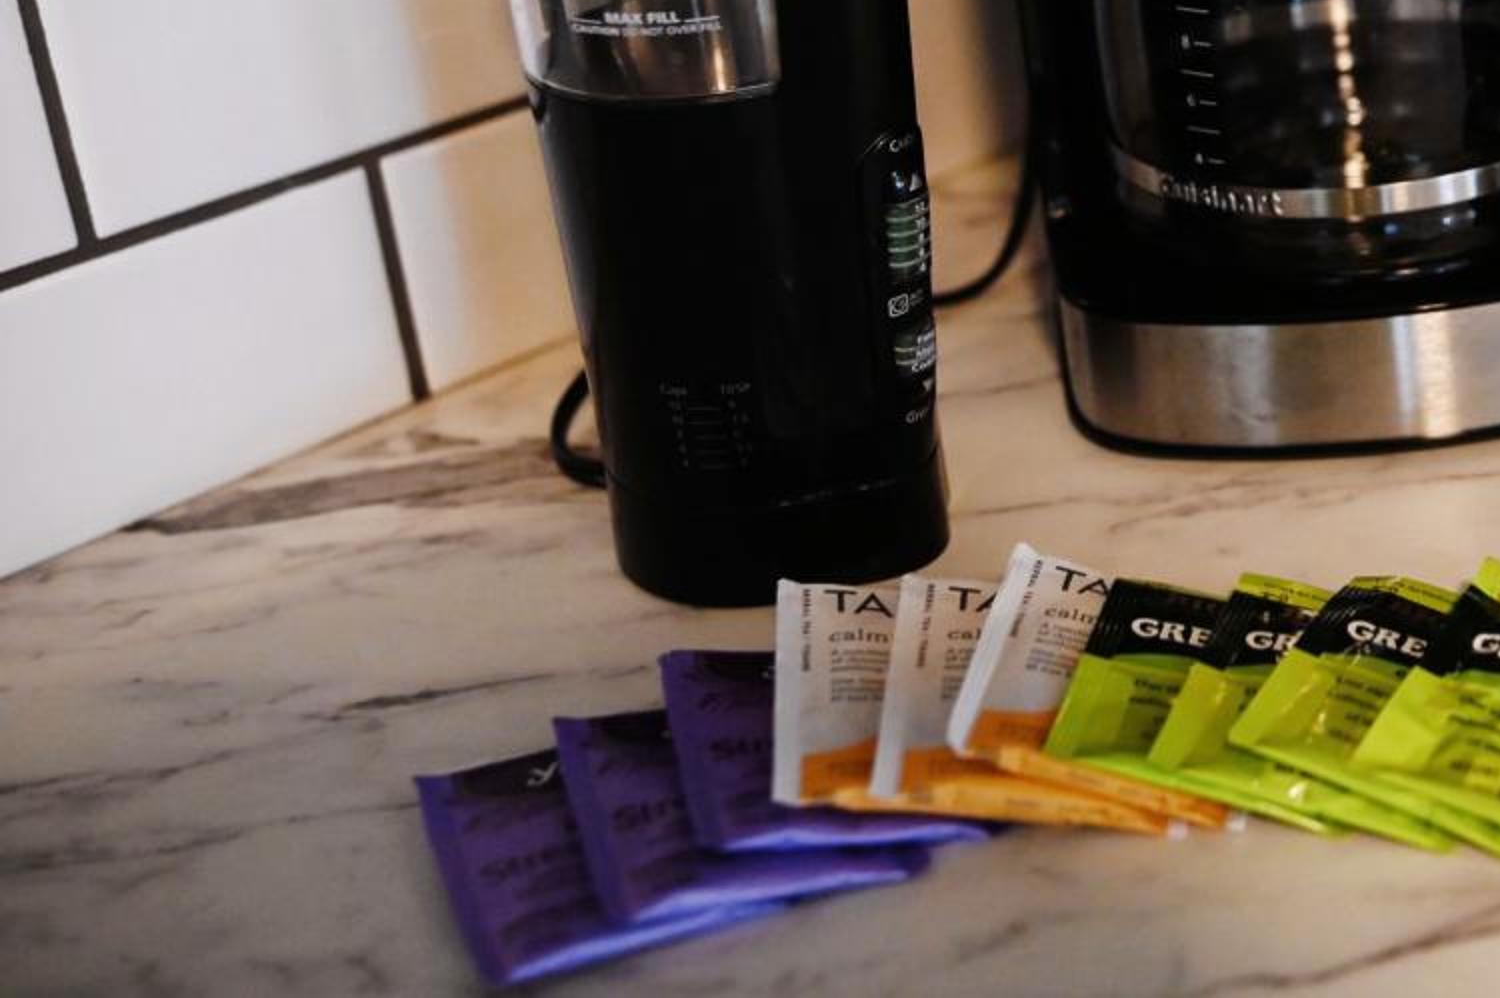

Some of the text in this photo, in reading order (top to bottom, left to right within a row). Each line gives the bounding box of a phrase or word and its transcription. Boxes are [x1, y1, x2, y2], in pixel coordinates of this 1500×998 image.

[604, 11, 680, 24] MAX FILL
[1055, 565, 1108, 594] TA
[823, 588, 894, 619] TA
[1131, 616, 1213, 646] GRE
[1346, 619, 1427, 657] GRE
